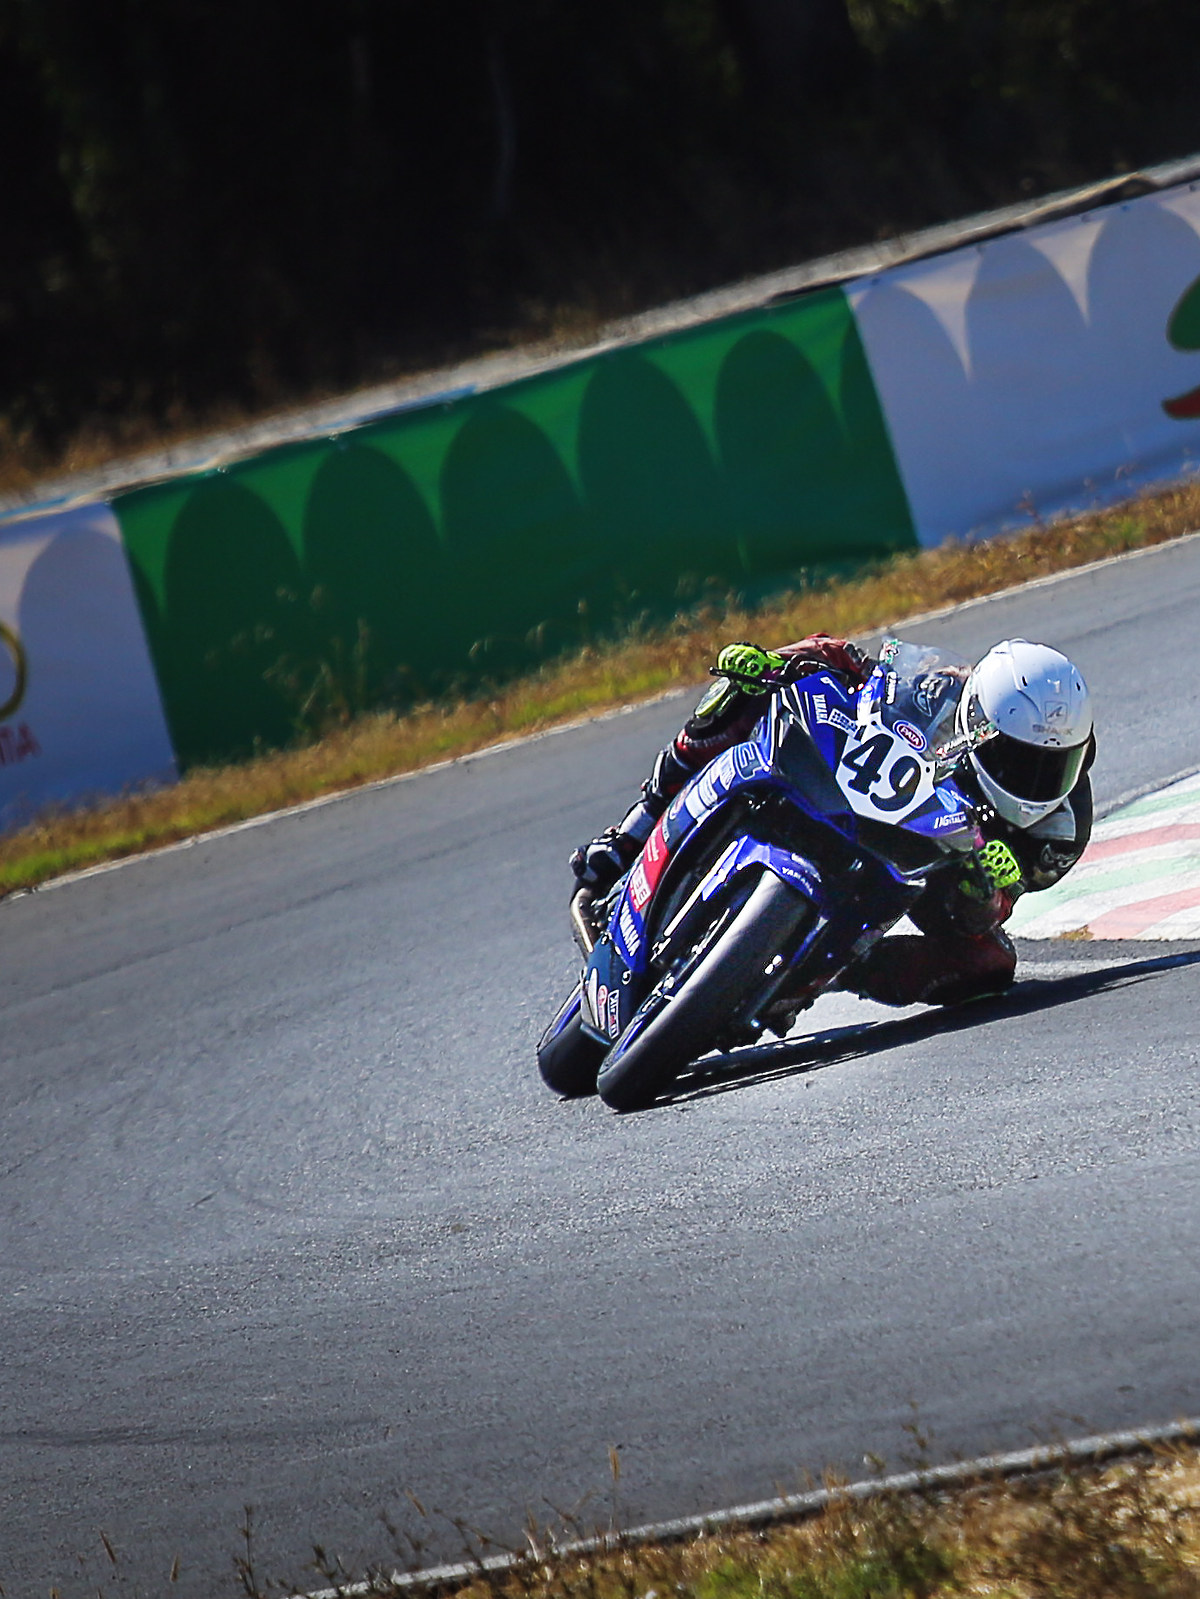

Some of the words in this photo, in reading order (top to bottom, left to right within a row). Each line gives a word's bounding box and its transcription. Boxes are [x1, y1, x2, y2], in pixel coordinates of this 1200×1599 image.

[812, 693, 828, 725] YAMAHA
[842, 733, 922, 812] 49
[781, 866, 814, 896] YAMAHA
[620, 900, 641, 957] YAMAHA
